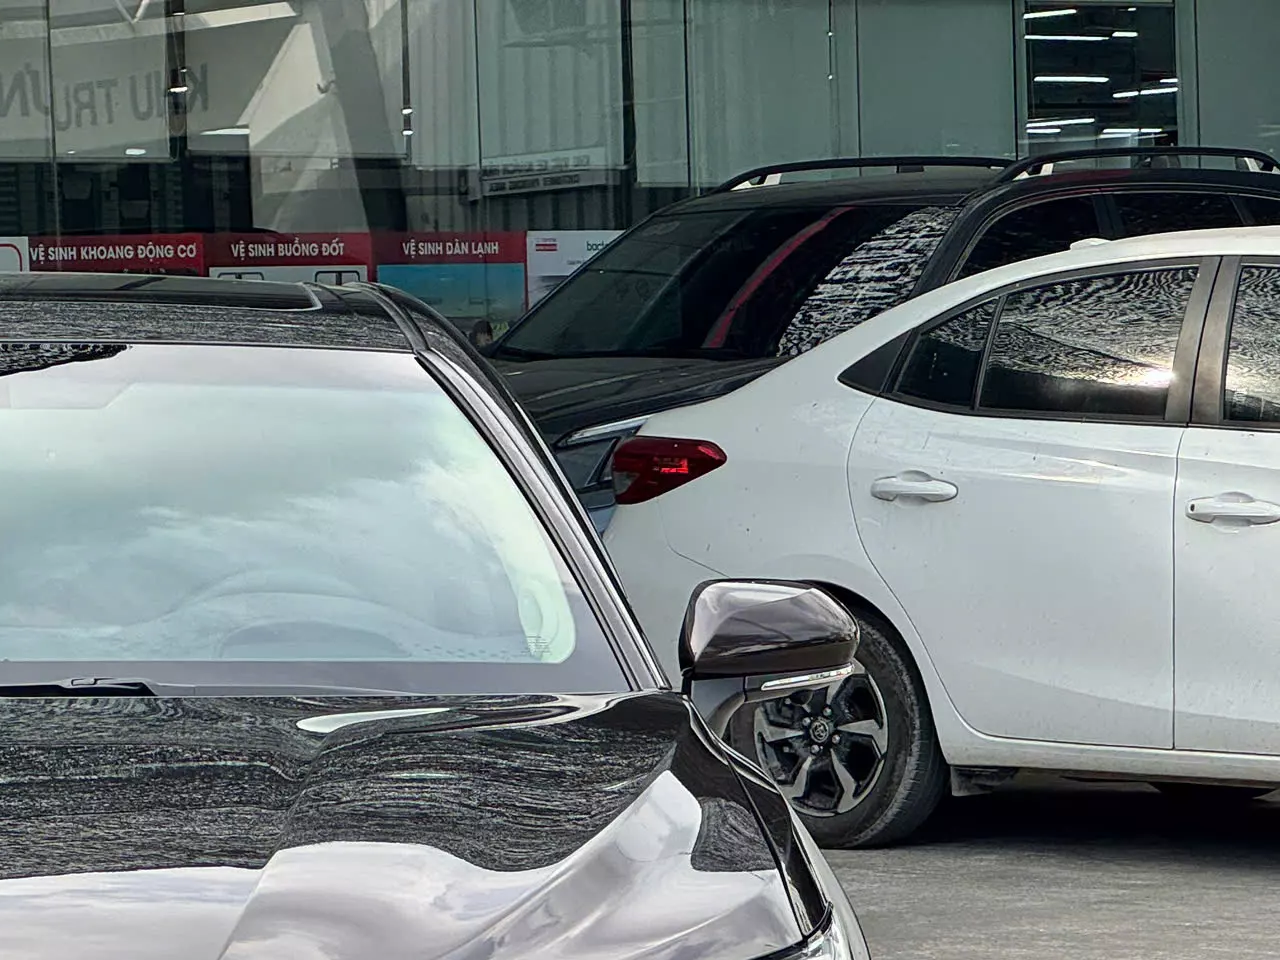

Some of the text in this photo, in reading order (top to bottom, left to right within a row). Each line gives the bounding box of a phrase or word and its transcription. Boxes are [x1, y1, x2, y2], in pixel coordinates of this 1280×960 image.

[30, 242, 197, 265] VỆ SINH KHOANG ĐỘNG CƠ
[230, 238, 345, 262] VỆ SINH BUỒNG ĐỐT
[402, 239, 499, 261] VỆ SINH DÀN LẠNH
